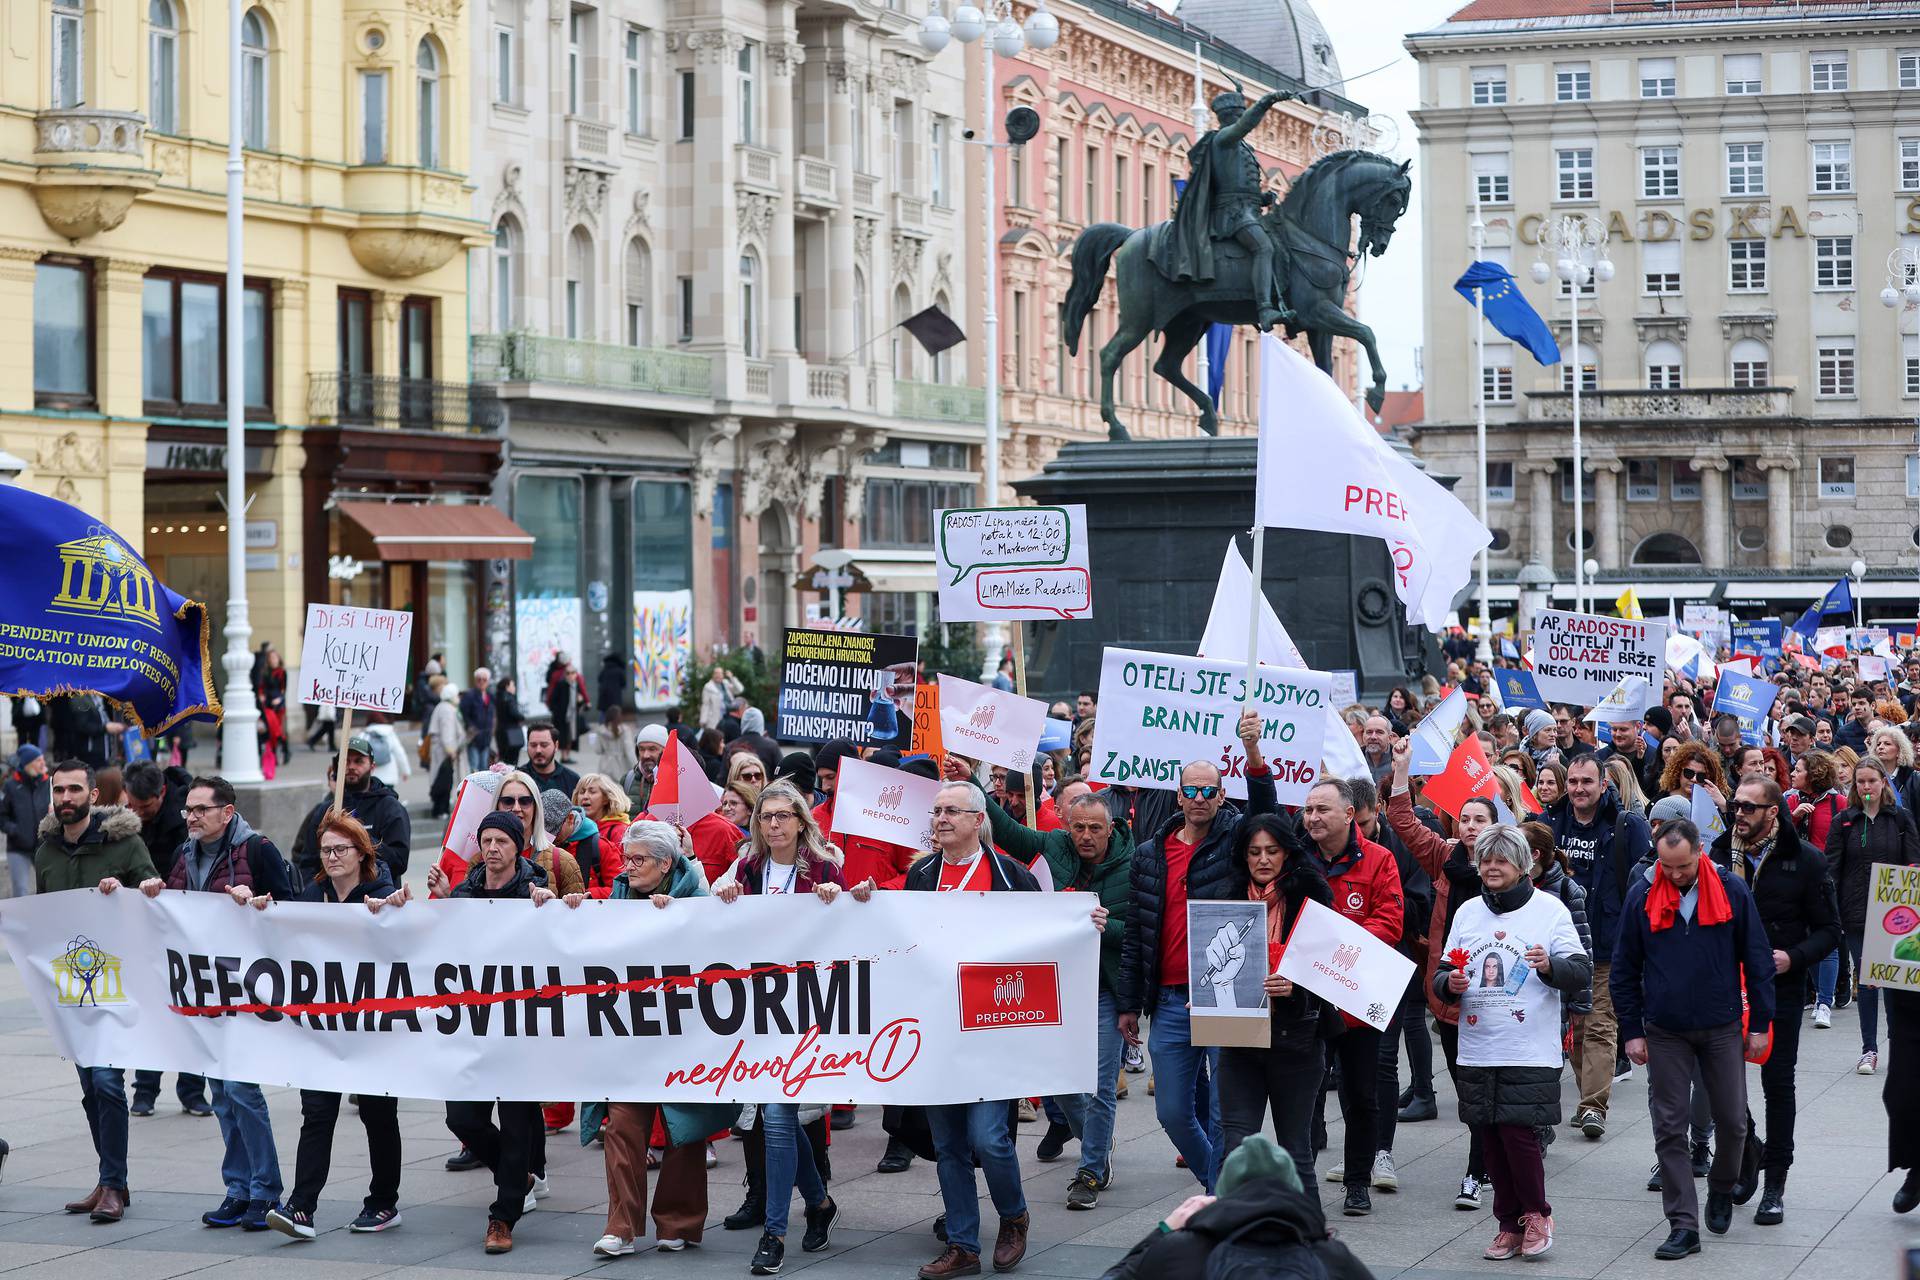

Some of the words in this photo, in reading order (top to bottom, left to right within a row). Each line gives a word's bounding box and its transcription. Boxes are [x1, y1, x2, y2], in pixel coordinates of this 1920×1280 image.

[946, 515, 981, 529] RADOST:
[1027, 527, 1060, 540] 12:00
[998, 543, 1040, 556] Markovom
[1540, 616, 1562, 632] AP,
[0, 623, 75, 645] PENDENT
[77, 633, 129, 650] UNION
[131, 639, 149, 654] OF
[787, 631, 842, 648] ZAPOSTAVLJENA
[842, 636, 876, 652] ZNANOST,
[1550, 631, 1614, 650] UČITELJI
[1619, 638, 1636, 652] TI
[322, 633, 379, 671] KOLIKI
[786, 645, 835, 660] NEPOKRENUTA
[835, 648, 873, 664] HRVATSKA.
[1549, 645, 1610, 664] ODLAZE
[1618, 651, 1657, 668] BRŽE
[87, 654, 162, 684] EMPLOYEES
[785, 659, 838, 687] HOĆEMO
[839, 667, 850, 688] LI
[852, 668, 882, 691] IKAD
[1538, 663, 1578, 679] NEGO
[1190, 669, 1232, 697] STE
[783, 688, 863, 716] PROMIJENITI
[915, 691, 936, 709] OLI
[782, 714, 875, 743] TRANSPARENT?
[954, 725, 1000, 745] PREPOROD
[1100, 751, 1182, 782] ZDRAVST
[1220, 744, 1315, 785] ŠKSTVO
[862, 808, 910, 826] PREPOROD
[1879, 867, 1896, 885] NE
[1504, 944, 1520, 957] RAM
[1312, 960, 1359, 991] PREPOROD
[1870, 963, 1900, 983] KROZ
[166, 948, 423, 1033] REFORMA
[434, 962, 566, 1038] SVIH
[583, 959, 872, 1038] REFORMI
[975, 1010, 1045, 1024] PREPOROD
